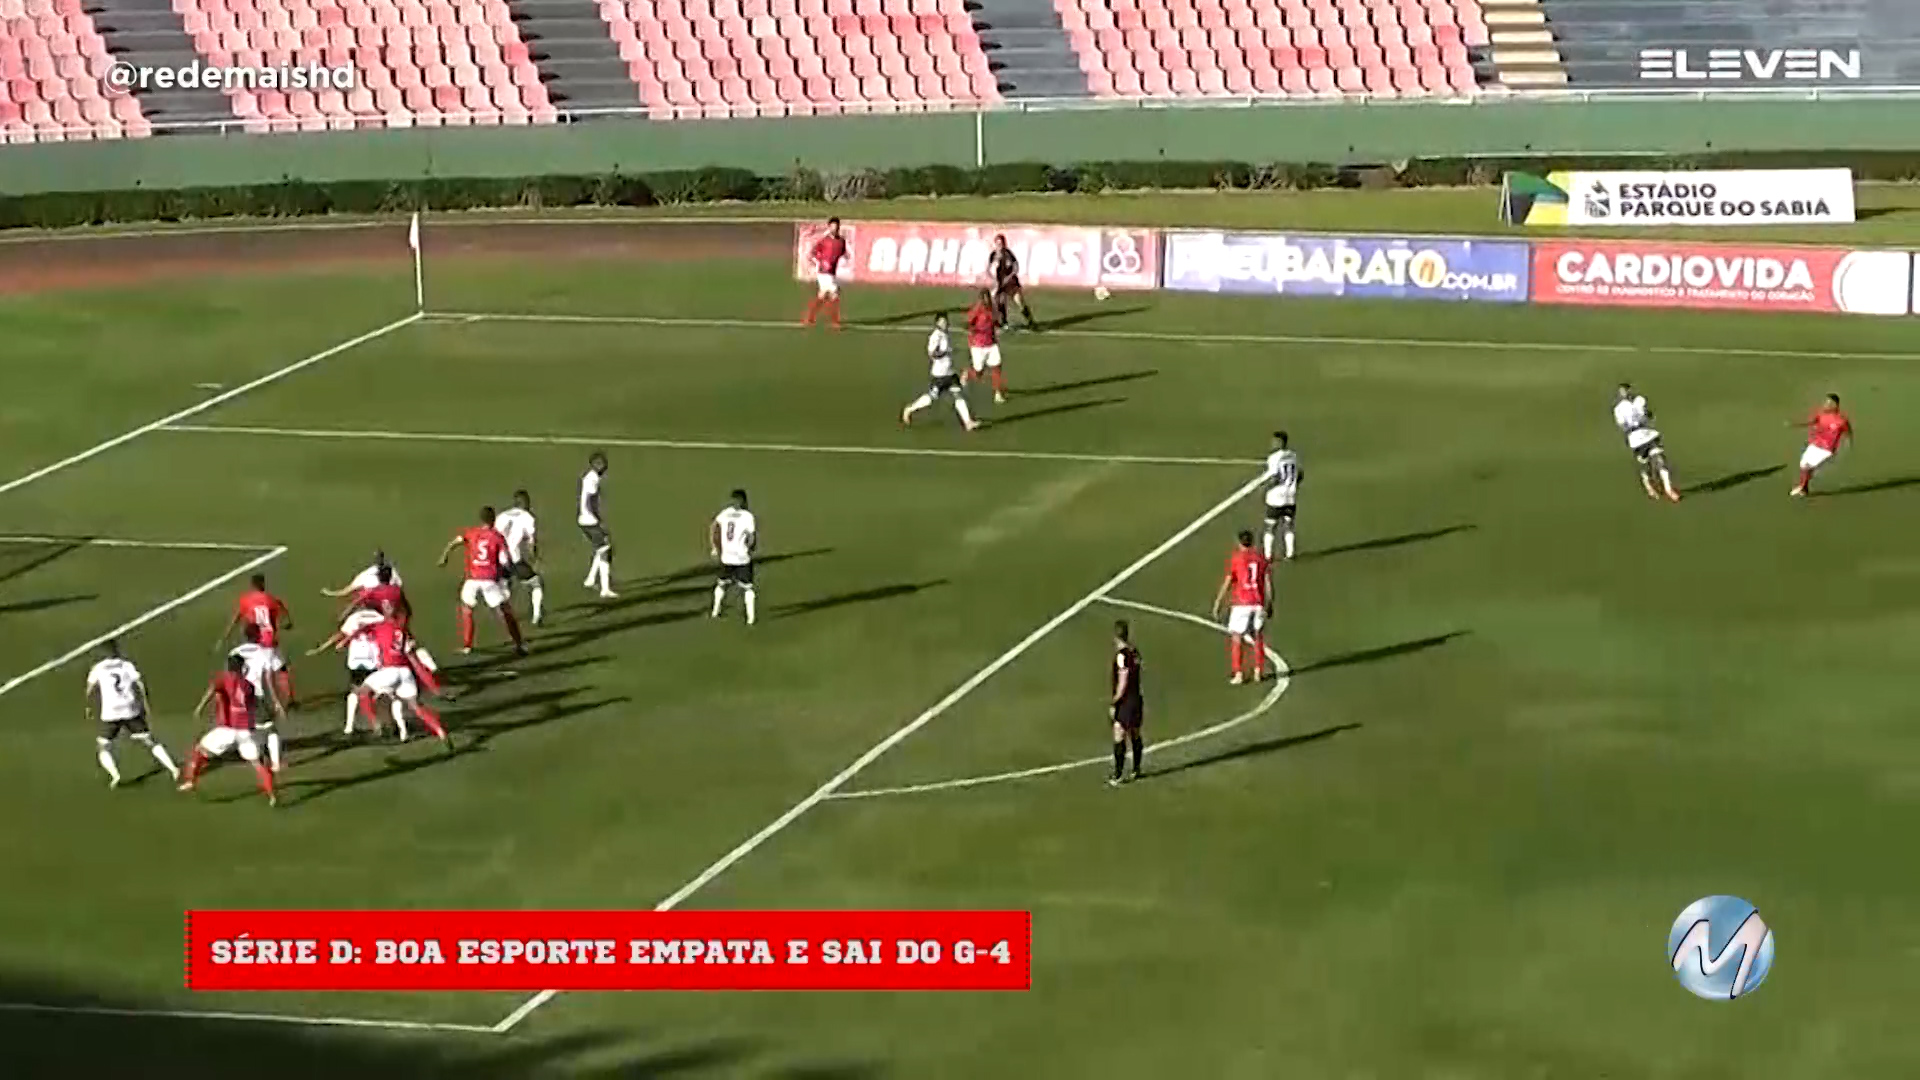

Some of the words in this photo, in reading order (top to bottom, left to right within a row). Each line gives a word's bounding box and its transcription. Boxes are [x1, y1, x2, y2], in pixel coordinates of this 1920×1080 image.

[1619, 180, 1717, 201] ESTÁDIO
[1619, 200, 1715, 217] PARQUE
[1721, 201, 1756, 217] DO
[1761, 197, 1832, 217] SABIÁ
[1556, 251, 1816, 290] CARDIOVIDA
[477, 538, 489, 560] 5
[112, 671, 127, 696] 2
